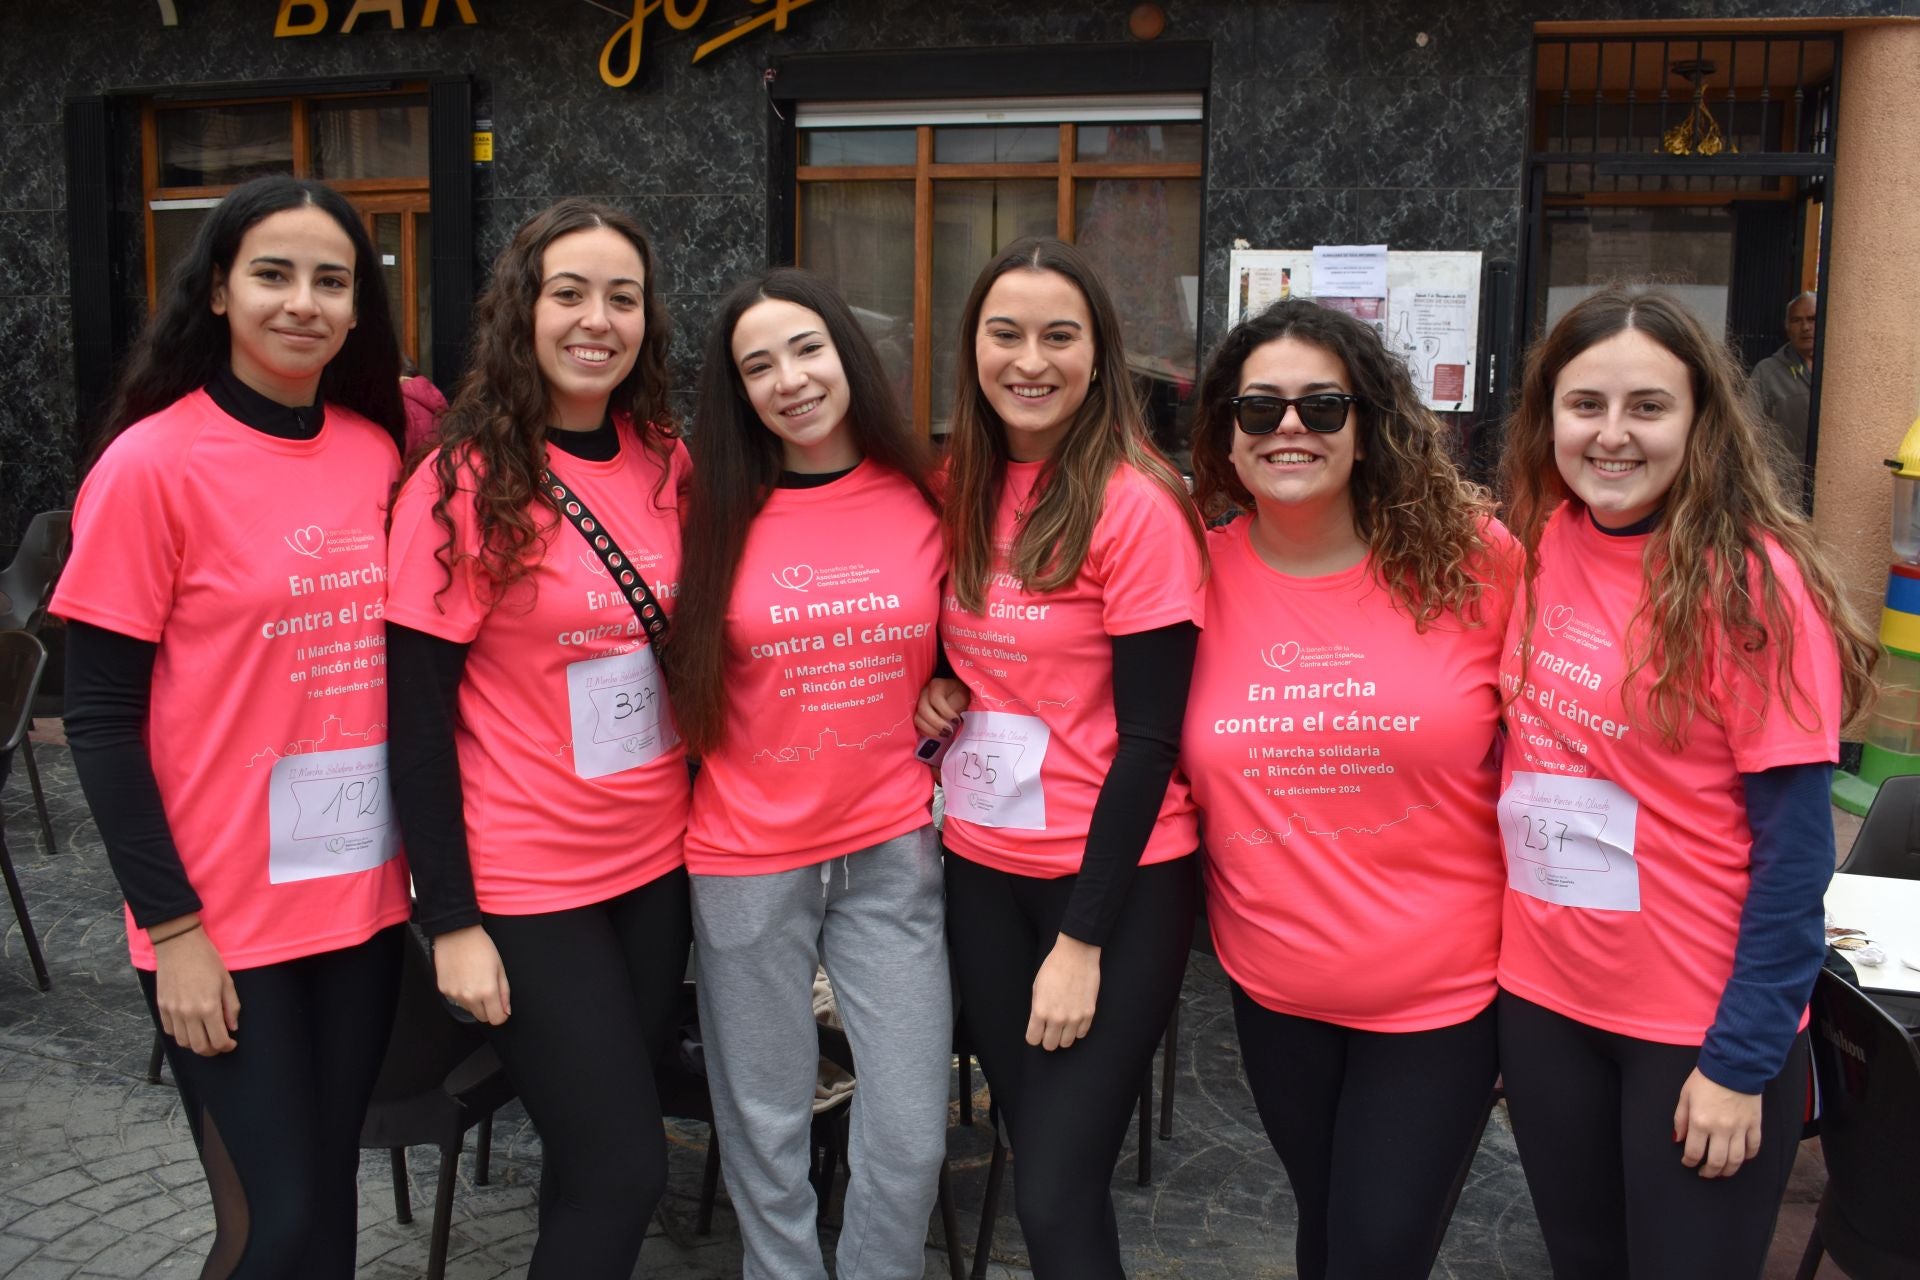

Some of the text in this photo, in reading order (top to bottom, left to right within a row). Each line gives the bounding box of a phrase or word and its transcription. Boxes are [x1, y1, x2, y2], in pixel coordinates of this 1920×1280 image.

[288, 575, 314, 596] En
[587, 590, 608, 610] En
[770, 592, 900, 625] En marcha
[989, 599, 1050, 620] cáncer
[262, 611, 333, 639] contra
[339, 602, 357, 625] el
[558, 616, 640, 645] contra el
[297, 634, 386, 661] II Marcha solida
[750, 622, 932, 659] contra el cáncer
[979, 630, 1016, 645] solidaria
[784, 652, 903, 680] II Marcha solidaria
[982, 646, 993, 657] de
[994, 648, 1028, 663] Olivedo
[290, 669, 306, 683] en
[311, 659, 351, 678] Rincón
[353, 656, 369, 671] de
[1536, 650, 1602, 691] marcha
[308, 691, 312, 700] 7
[314, 689, 324, 699] de
[325, 682, 369, 697] diciembre
[780, 688, 796, 698] en
[803, 678, 847, 694] Rincón
[850, 676, 866, 688] de
[1248, 678, 1376, 701] En marcha
[801, 692, 884, 712] 7 de diciembre 2024
[1509, 705, 1515, 717] II
[1214, 710, 1420, 734] contra el cáncer
[1540, 688, 1556, 710] el
[1558, 700, 1629, 740] cáncer
[1249, 745, 1381, 759] II Marcha solidaria
[962, 751, 1000, 784] 235
[1244, 763, 1395, 777] en Rincón de Olivedo
[322, 776, 381, 823] 192
[1274, 788, 1286, 796] de
[1288, 786, 1337, 796] diciembre
[1338, 785, 1361, 794] 2024
[1522, 816, 1574, 853] 237
